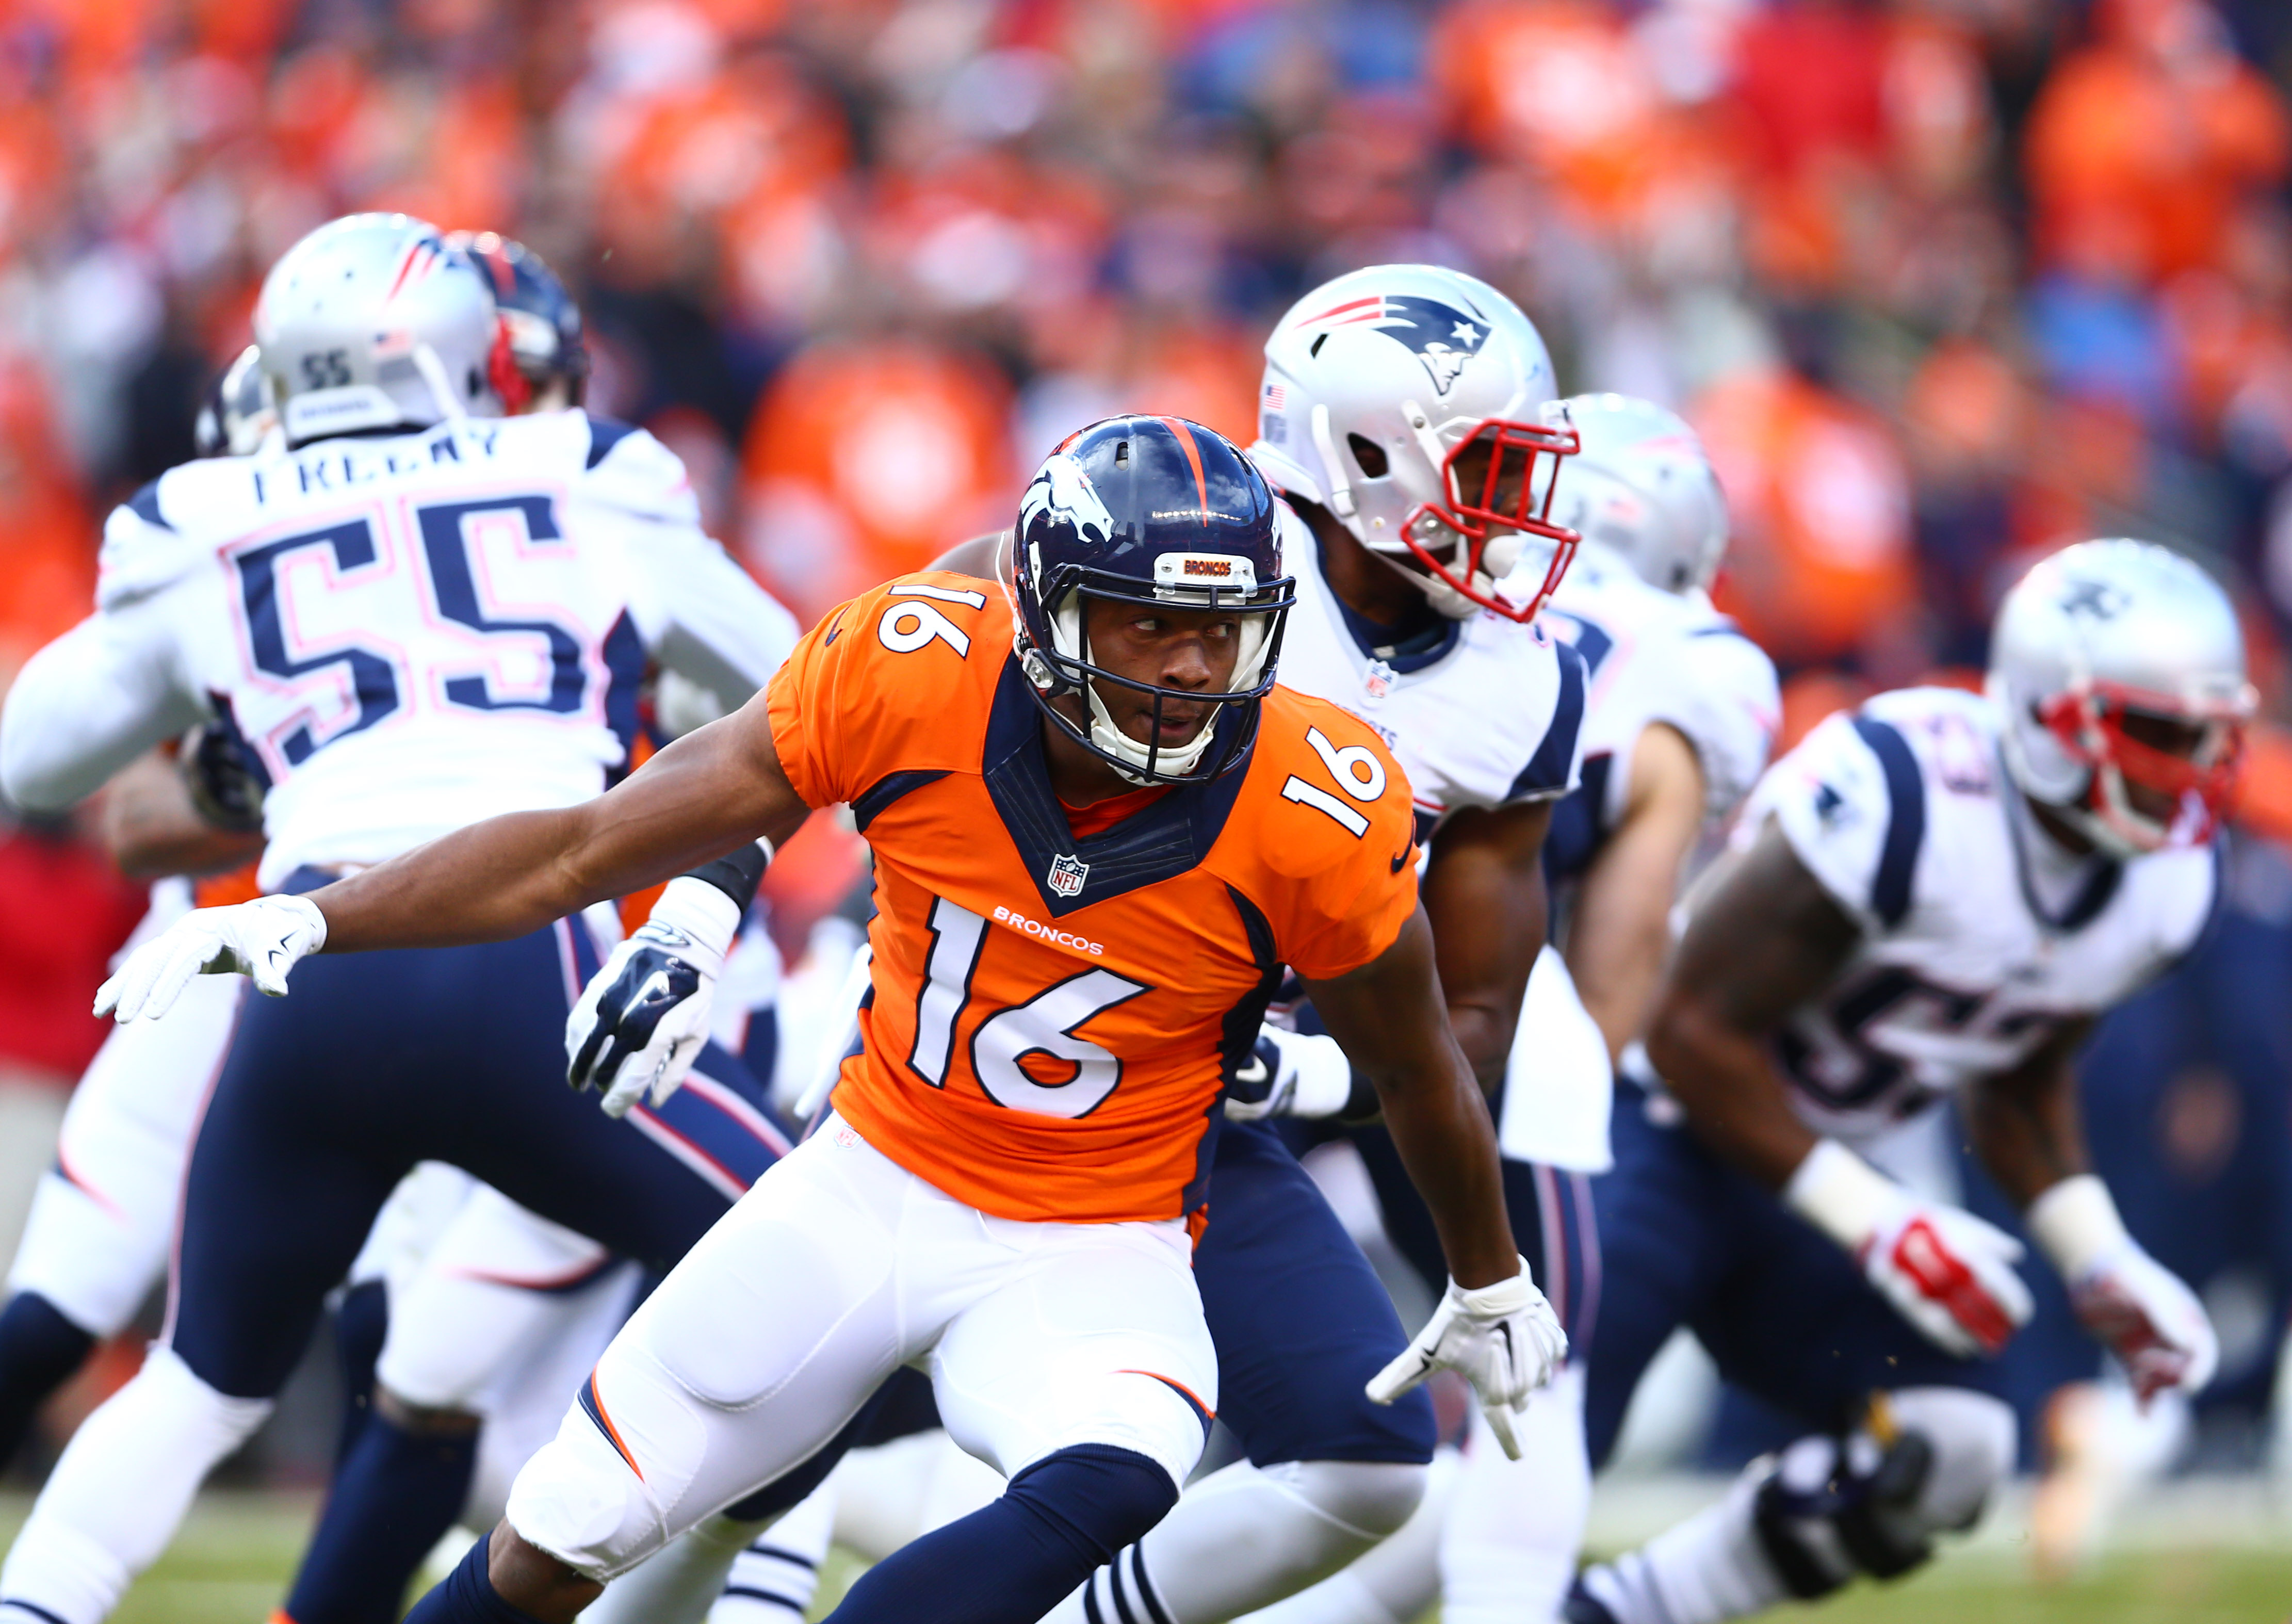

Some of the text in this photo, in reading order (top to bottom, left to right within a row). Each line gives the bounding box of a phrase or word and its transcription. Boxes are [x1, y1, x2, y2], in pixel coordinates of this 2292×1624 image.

[1183, 560, 1231, 576] BRONCOS
[227, 488, 596, 774] 55
[877, 584, 986, 661] 16
[1280, 725, 1386, 840] 16
[1053, 870, 1077, 891] NFL
[993, 905, 1104, 955] BRONCOS
[905, 896, 1156, 1119] 16
